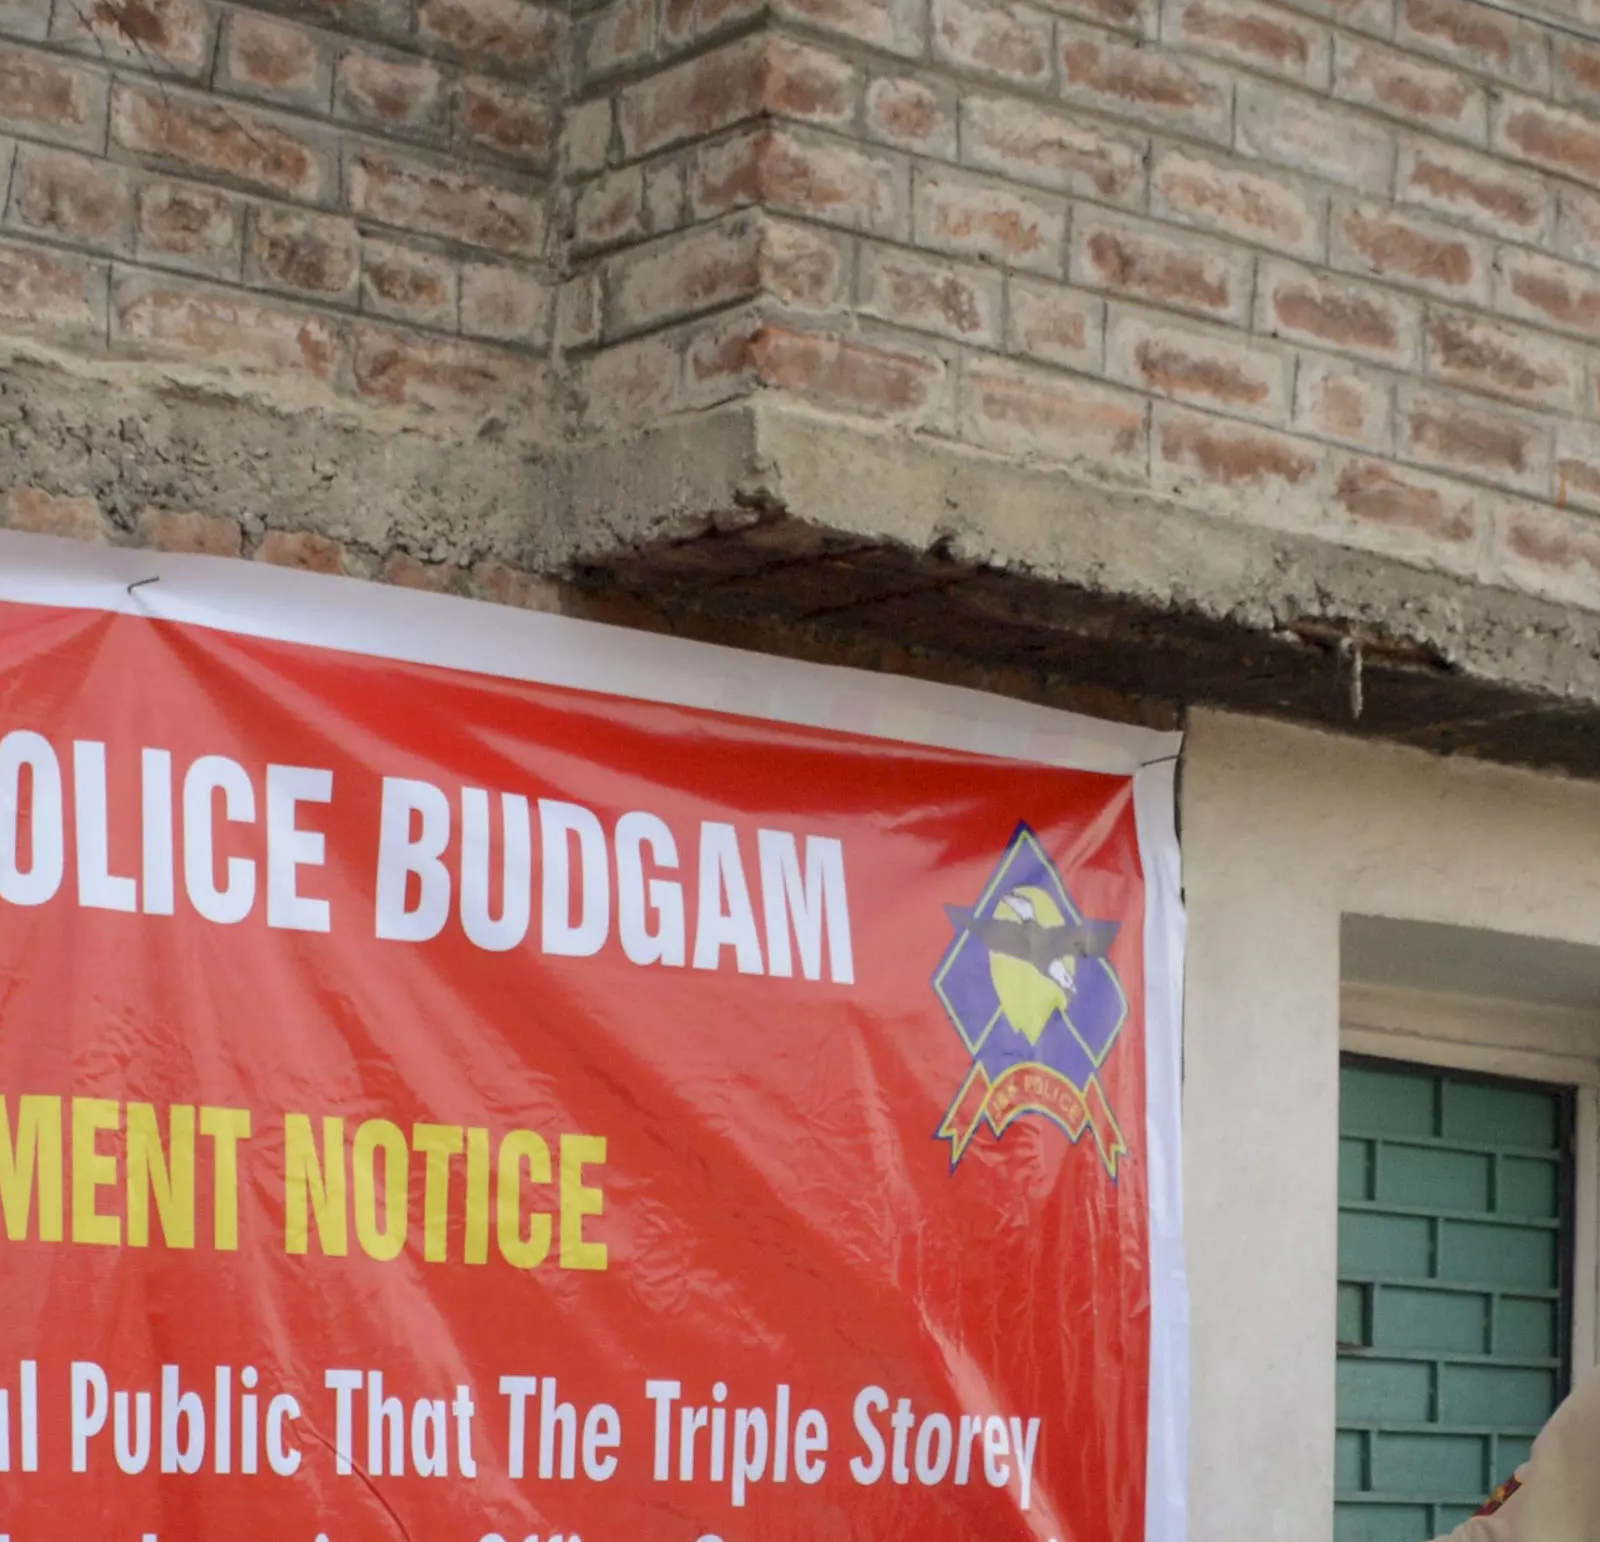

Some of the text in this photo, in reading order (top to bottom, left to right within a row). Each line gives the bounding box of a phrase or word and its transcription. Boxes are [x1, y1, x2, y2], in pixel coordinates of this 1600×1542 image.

[374, 775, 858, 988] BUDGAM
[284, 1112, 608, 1270] NOTICE
[70, 1360, 303, 1477] Public
[324, 1368, 479, 1479] That
[498, 1375, 621, 1482] The
[645, 1379, 829, 1507] Triple
[849, 1385, 1042, 1513] Storey
